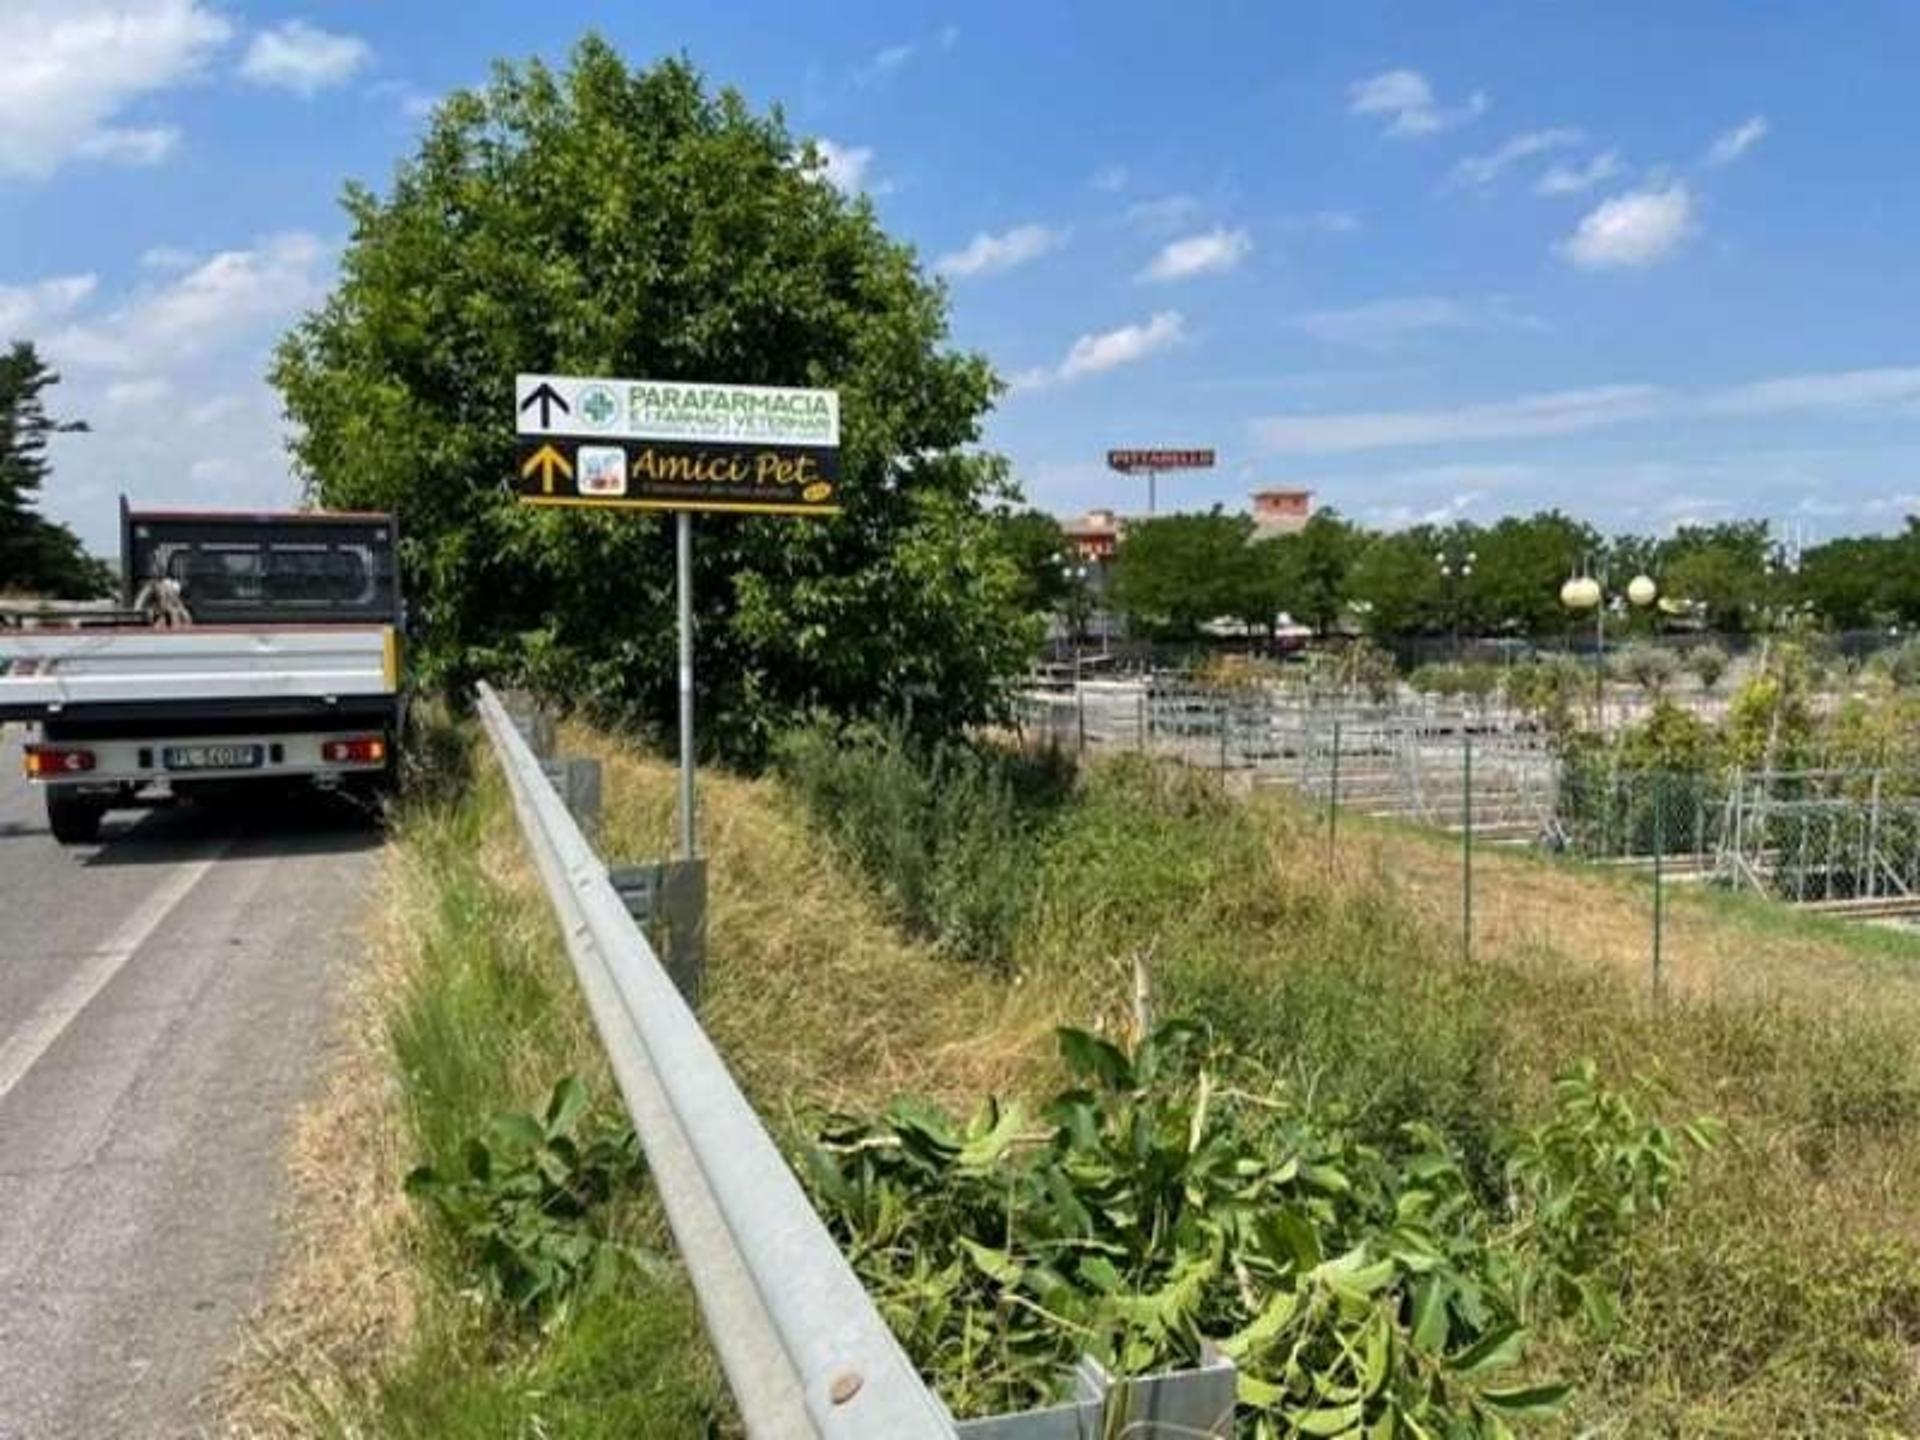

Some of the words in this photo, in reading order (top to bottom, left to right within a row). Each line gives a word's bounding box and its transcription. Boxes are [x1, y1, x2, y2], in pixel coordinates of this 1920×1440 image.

[629, 385, 830, 415] PARAFARMACIA
[632, 447, 748, 482] Amici
[755, 452, 819, 485] Pet
